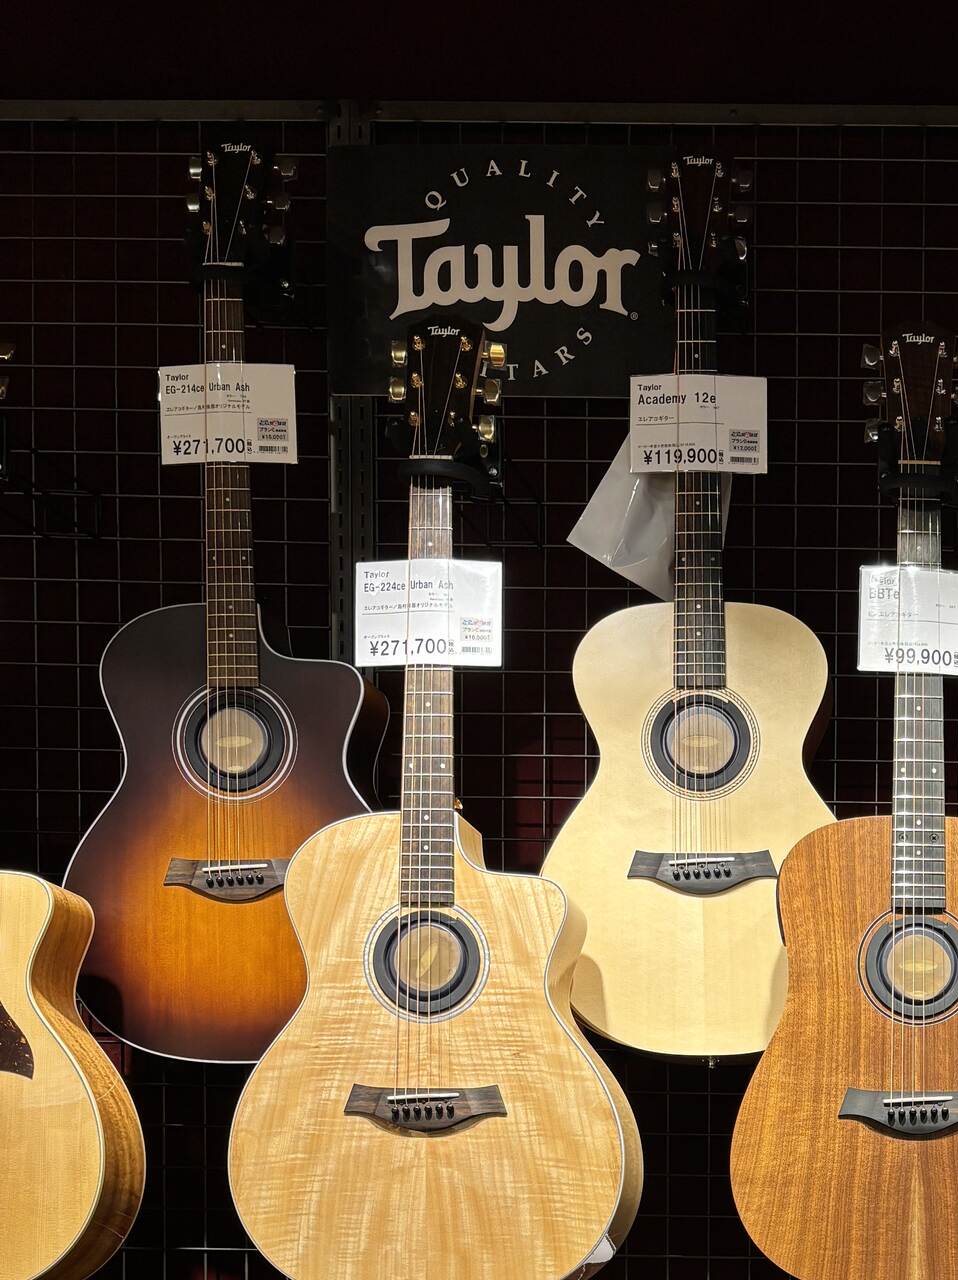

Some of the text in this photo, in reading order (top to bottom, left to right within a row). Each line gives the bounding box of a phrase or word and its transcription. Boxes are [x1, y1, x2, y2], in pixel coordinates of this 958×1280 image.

[221, 142, 251, 154] Taylor
[682, 155, 714, 166] Taylor
[424, 159, 605, 228] QUALITY
[364, 214, 640, 332] Taylor
[427, 326, 460, 338] Taylor
[902, 333, 935, 345] Taylor
[165, 374, 189, 382] Taylor
[165, 382, 250, 394] EG-214ce Urban Ash
[638, 384, 662, 392] Taylor
[638, 392, 716, 405] Academy 12e
[173, 438, 245, 455] ¥271,700
[643, 448, 717, 465] ¥119,900
[364, 582, 406, 592] EG-224ce
[410, 580, 433, 590] Urban
[370, 638, 446, 656] ¥271,700
[885, 647, 951, 666] ¥99,900
